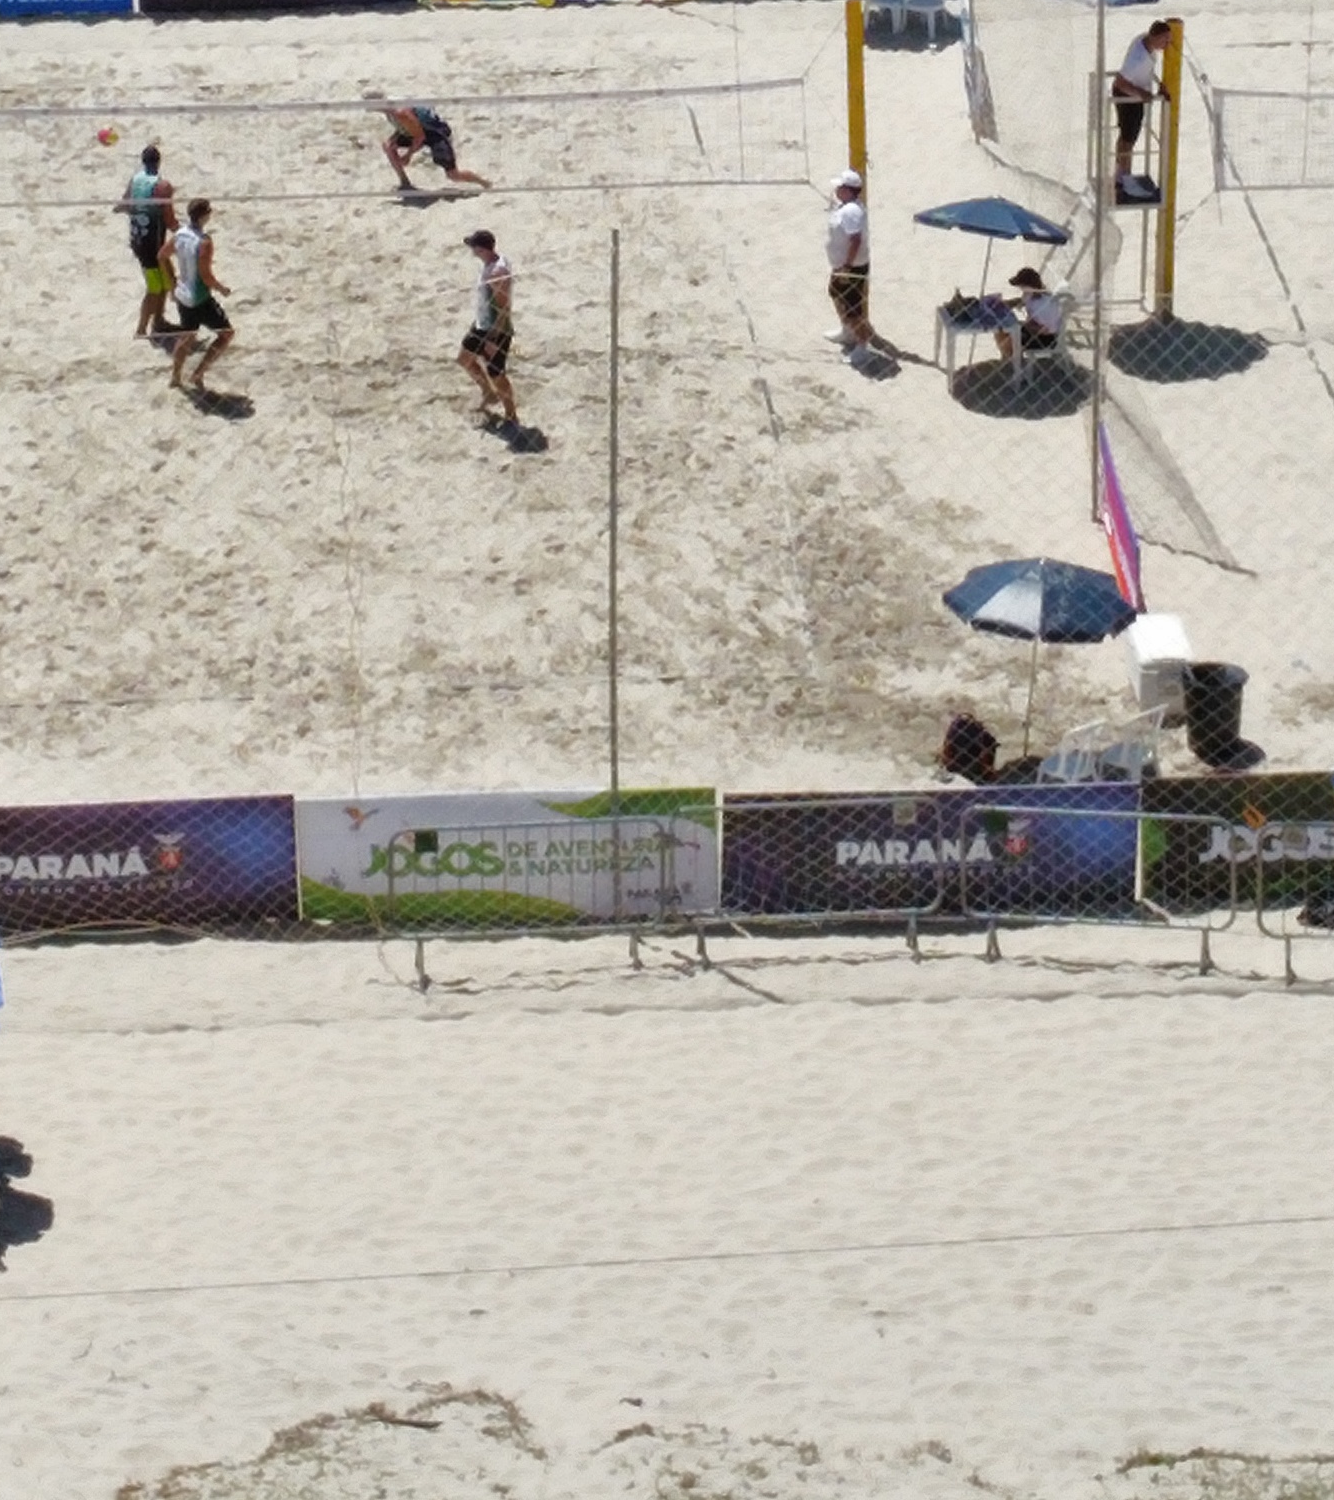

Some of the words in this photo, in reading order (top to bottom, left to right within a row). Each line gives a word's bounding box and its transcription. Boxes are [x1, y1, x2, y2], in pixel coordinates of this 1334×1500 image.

[361, 841, 505, 879] JOGOS
[507, 841, 531, 859] DE
[836, 829, 993, 866] PARANÁ
[527, 856, 654, 877] NATUREZA
